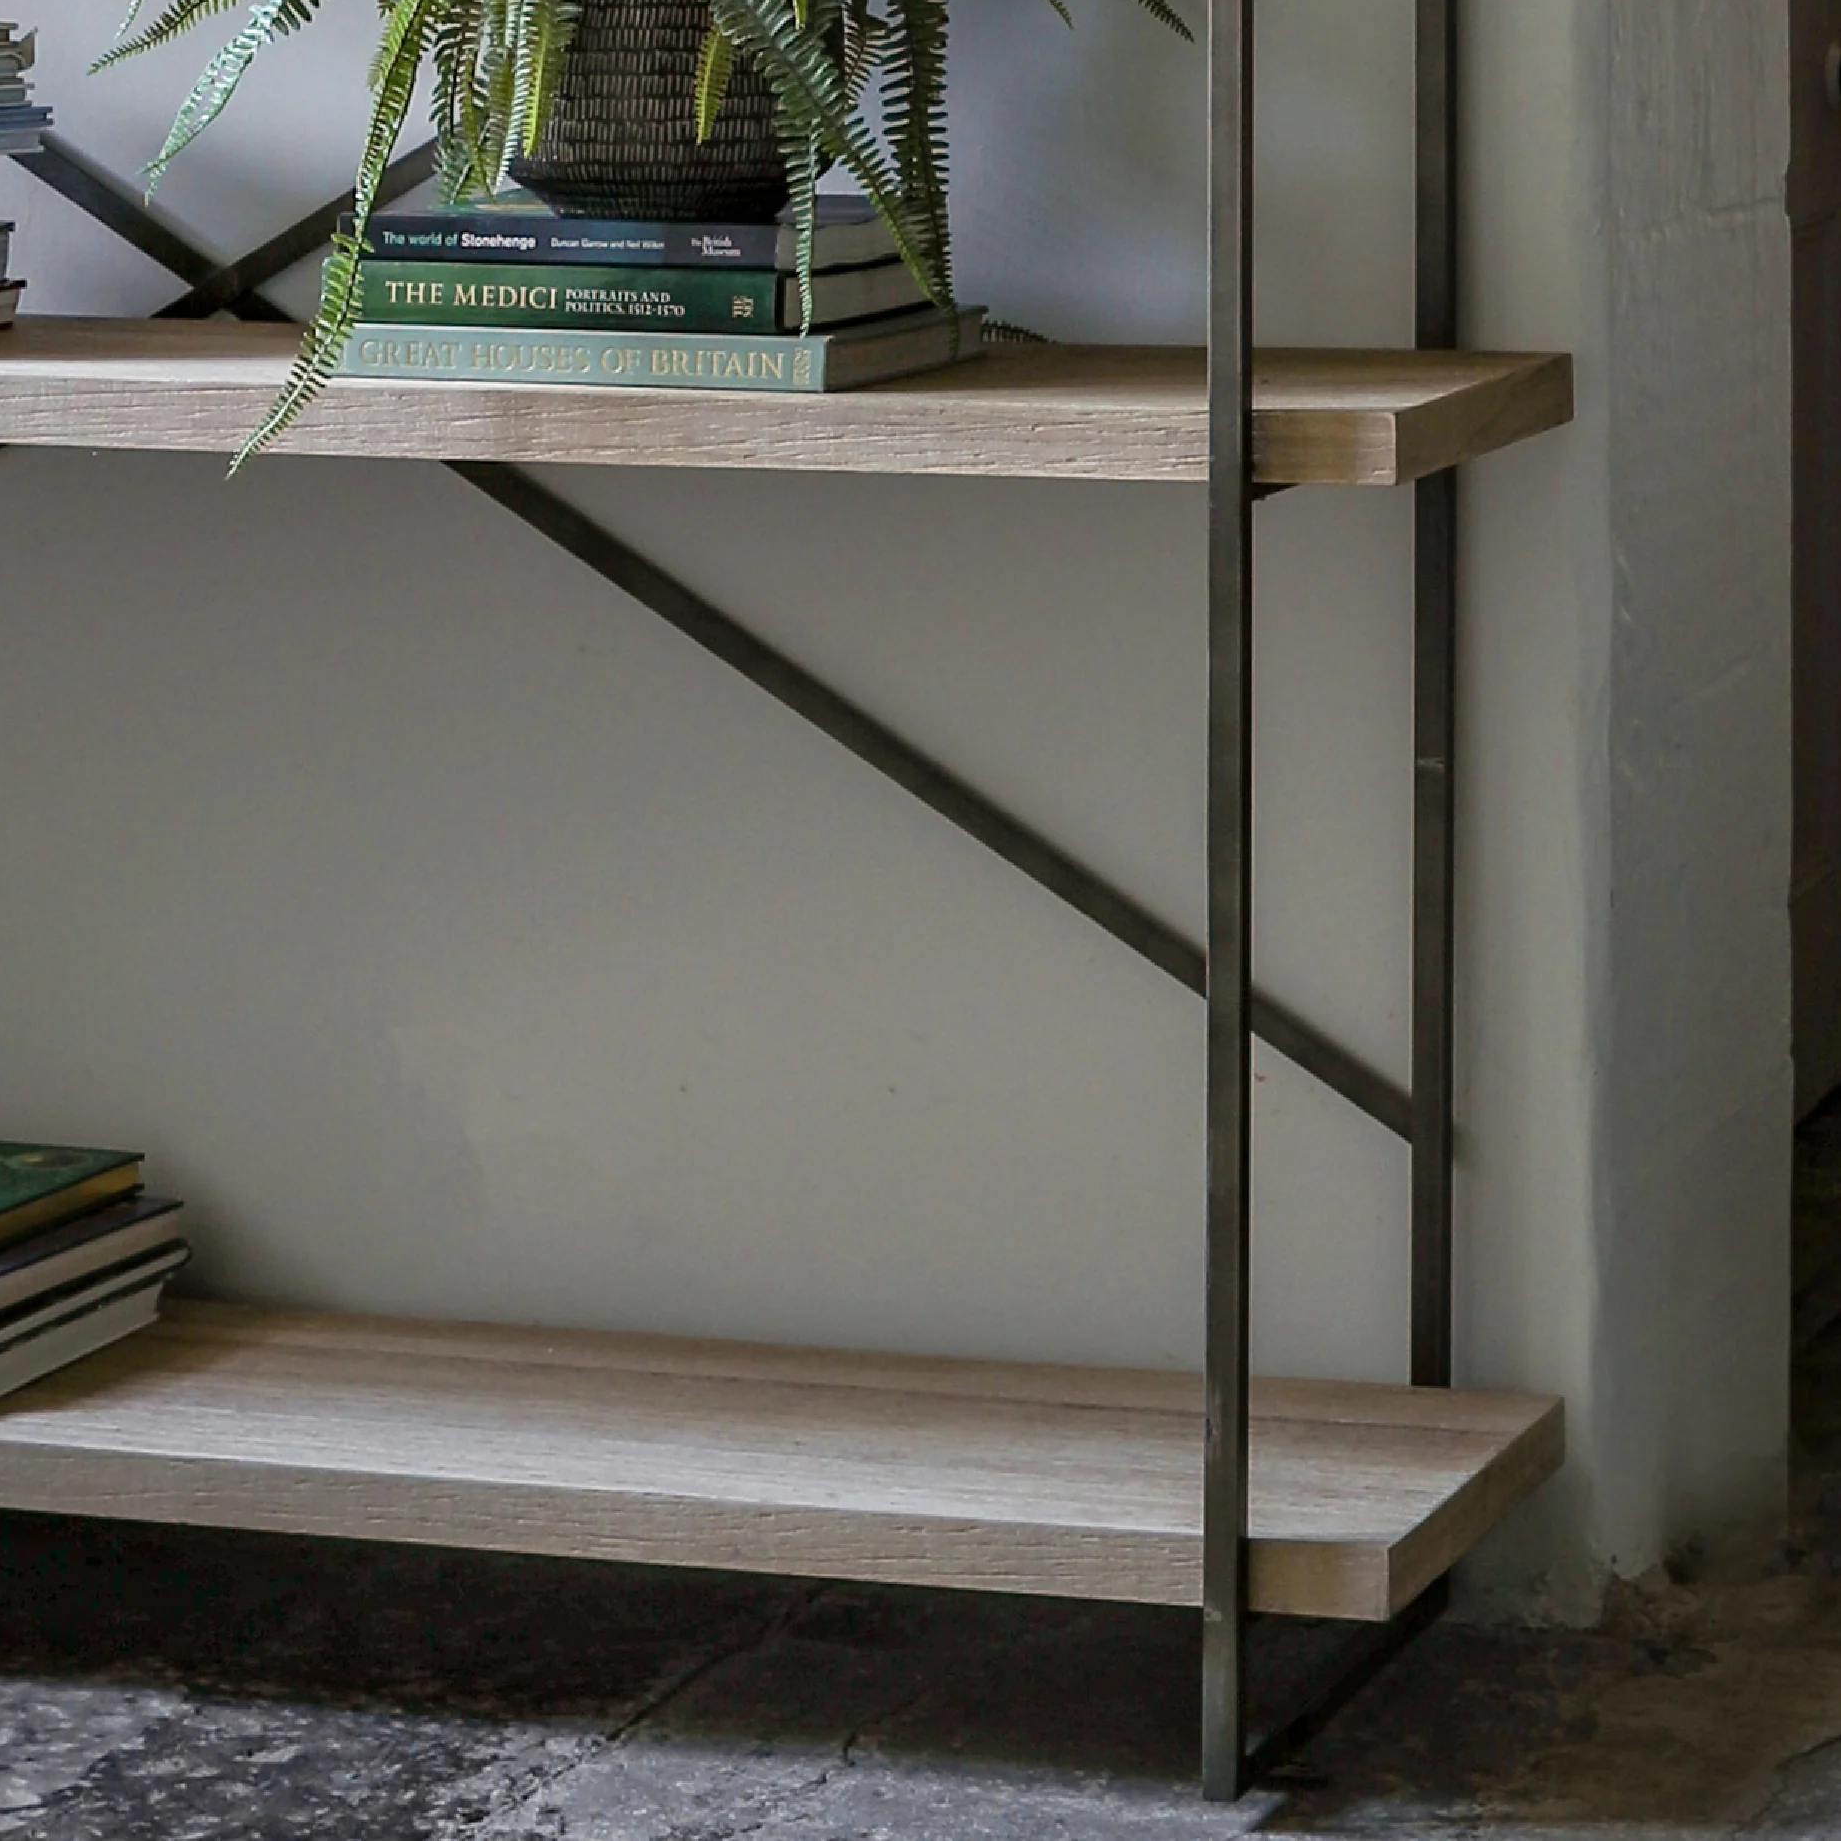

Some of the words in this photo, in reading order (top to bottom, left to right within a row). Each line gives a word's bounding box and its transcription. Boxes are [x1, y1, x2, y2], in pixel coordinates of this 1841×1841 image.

[382, 231, 406, 246] The
[407, 232, 441, 247] world
[443, 232, 458, 247] of
[461, 233, 537, 251] Stonehenge
[385, 280, 443, 306] THE
[455, 282, 556, 310] MEDICI
[565, 289, 638, 303] PORTRAITS
[640, 291, 671, 304] AND
[360, 338, 462, 369] GREAT
[472, 343, 590, 374] HOUSES
[600, 346, 637, 375] OF
[651, 348, 784, 379] BRITAIN
